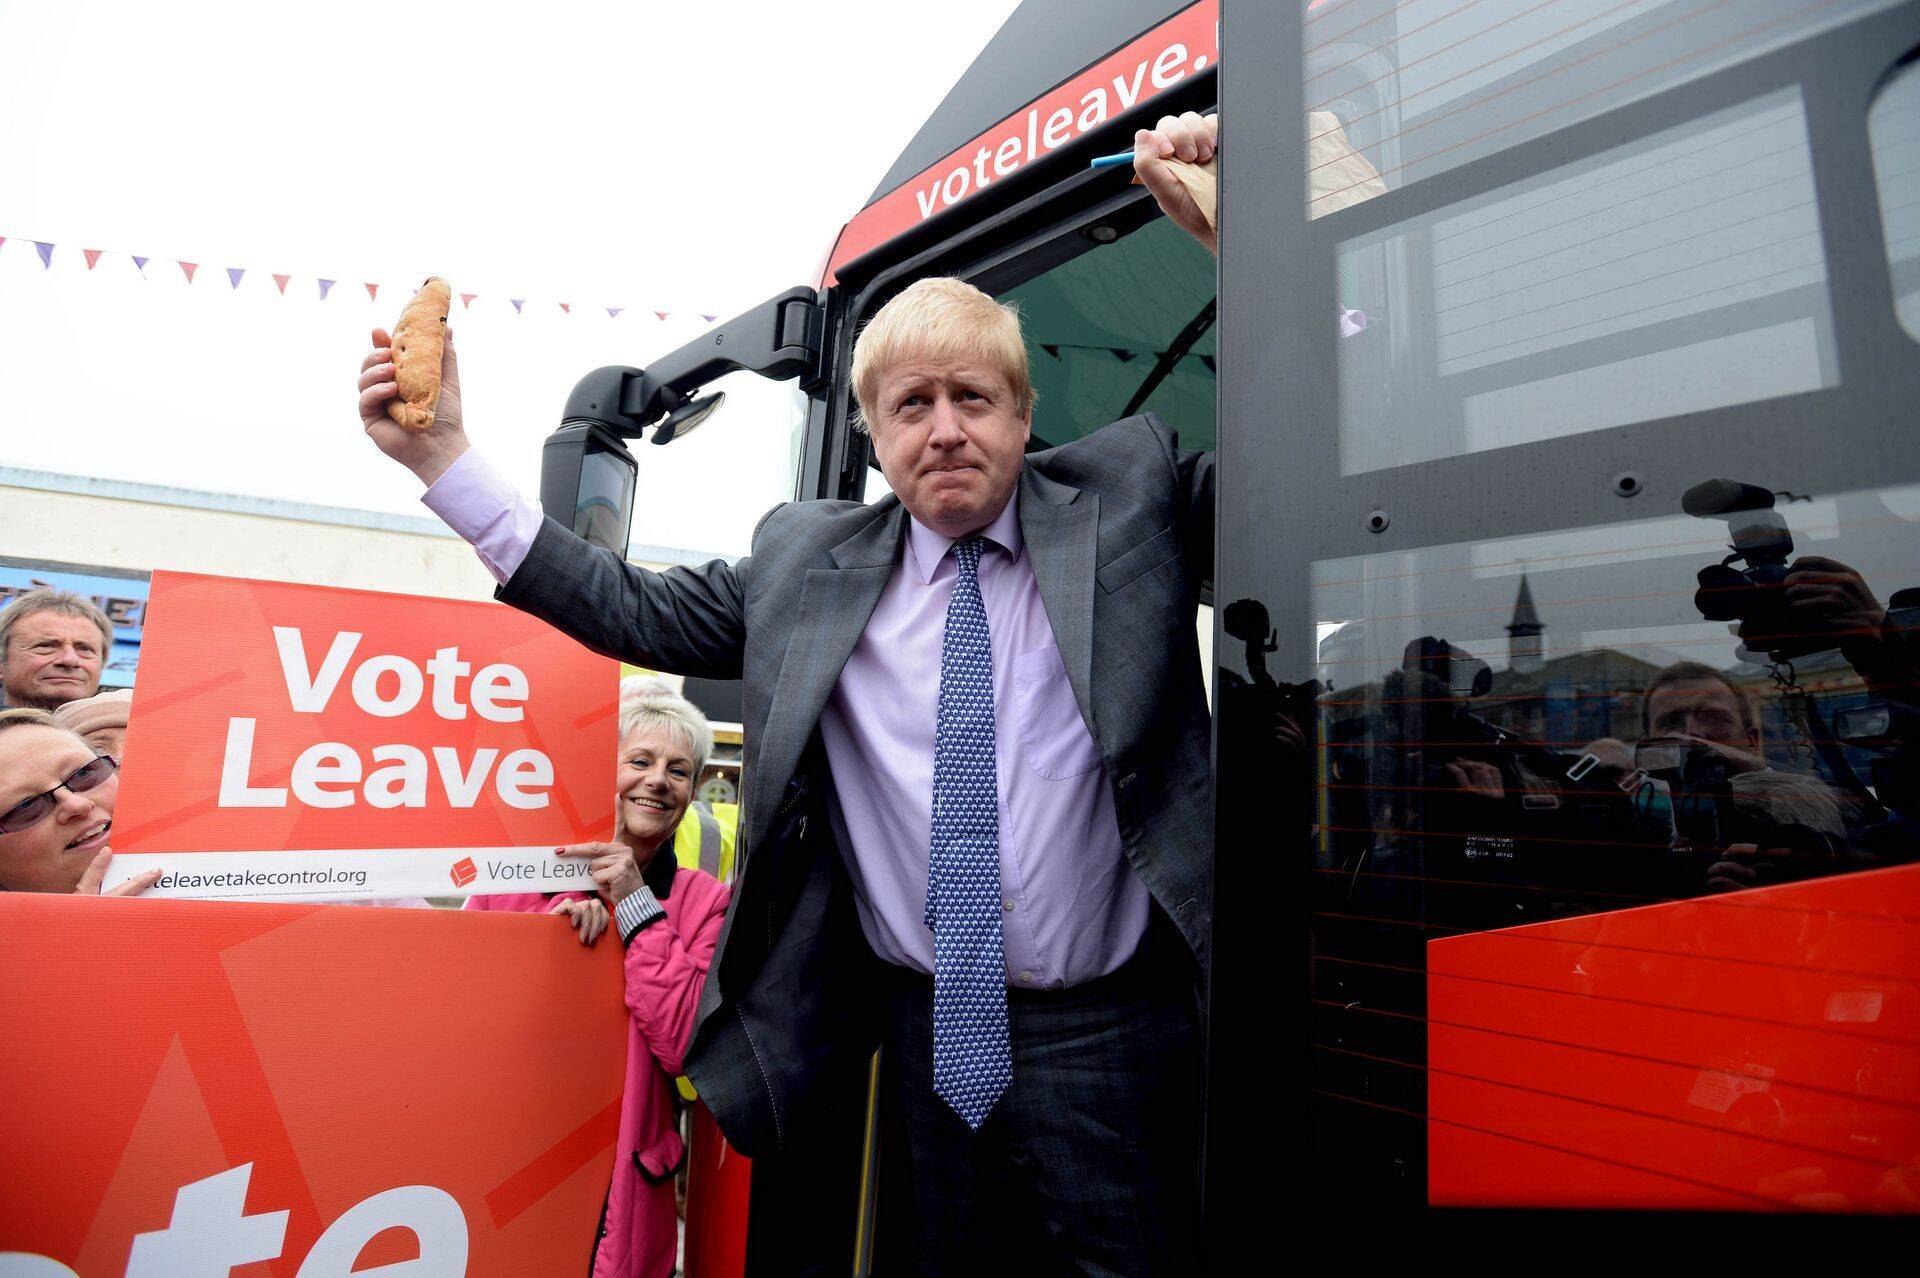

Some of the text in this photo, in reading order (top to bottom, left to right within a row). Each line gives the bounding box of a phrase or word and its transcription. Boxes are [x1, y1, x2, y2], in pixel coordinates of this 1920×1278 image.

[915, 20, 1218, 220] voteleave.
[272, 626, 529, 722] Vote
[218, 717, 554, 809] Leave
[127, 868, 367, 888] eleavetakecontrol.org
[487, 861, 536, 880] Vote
